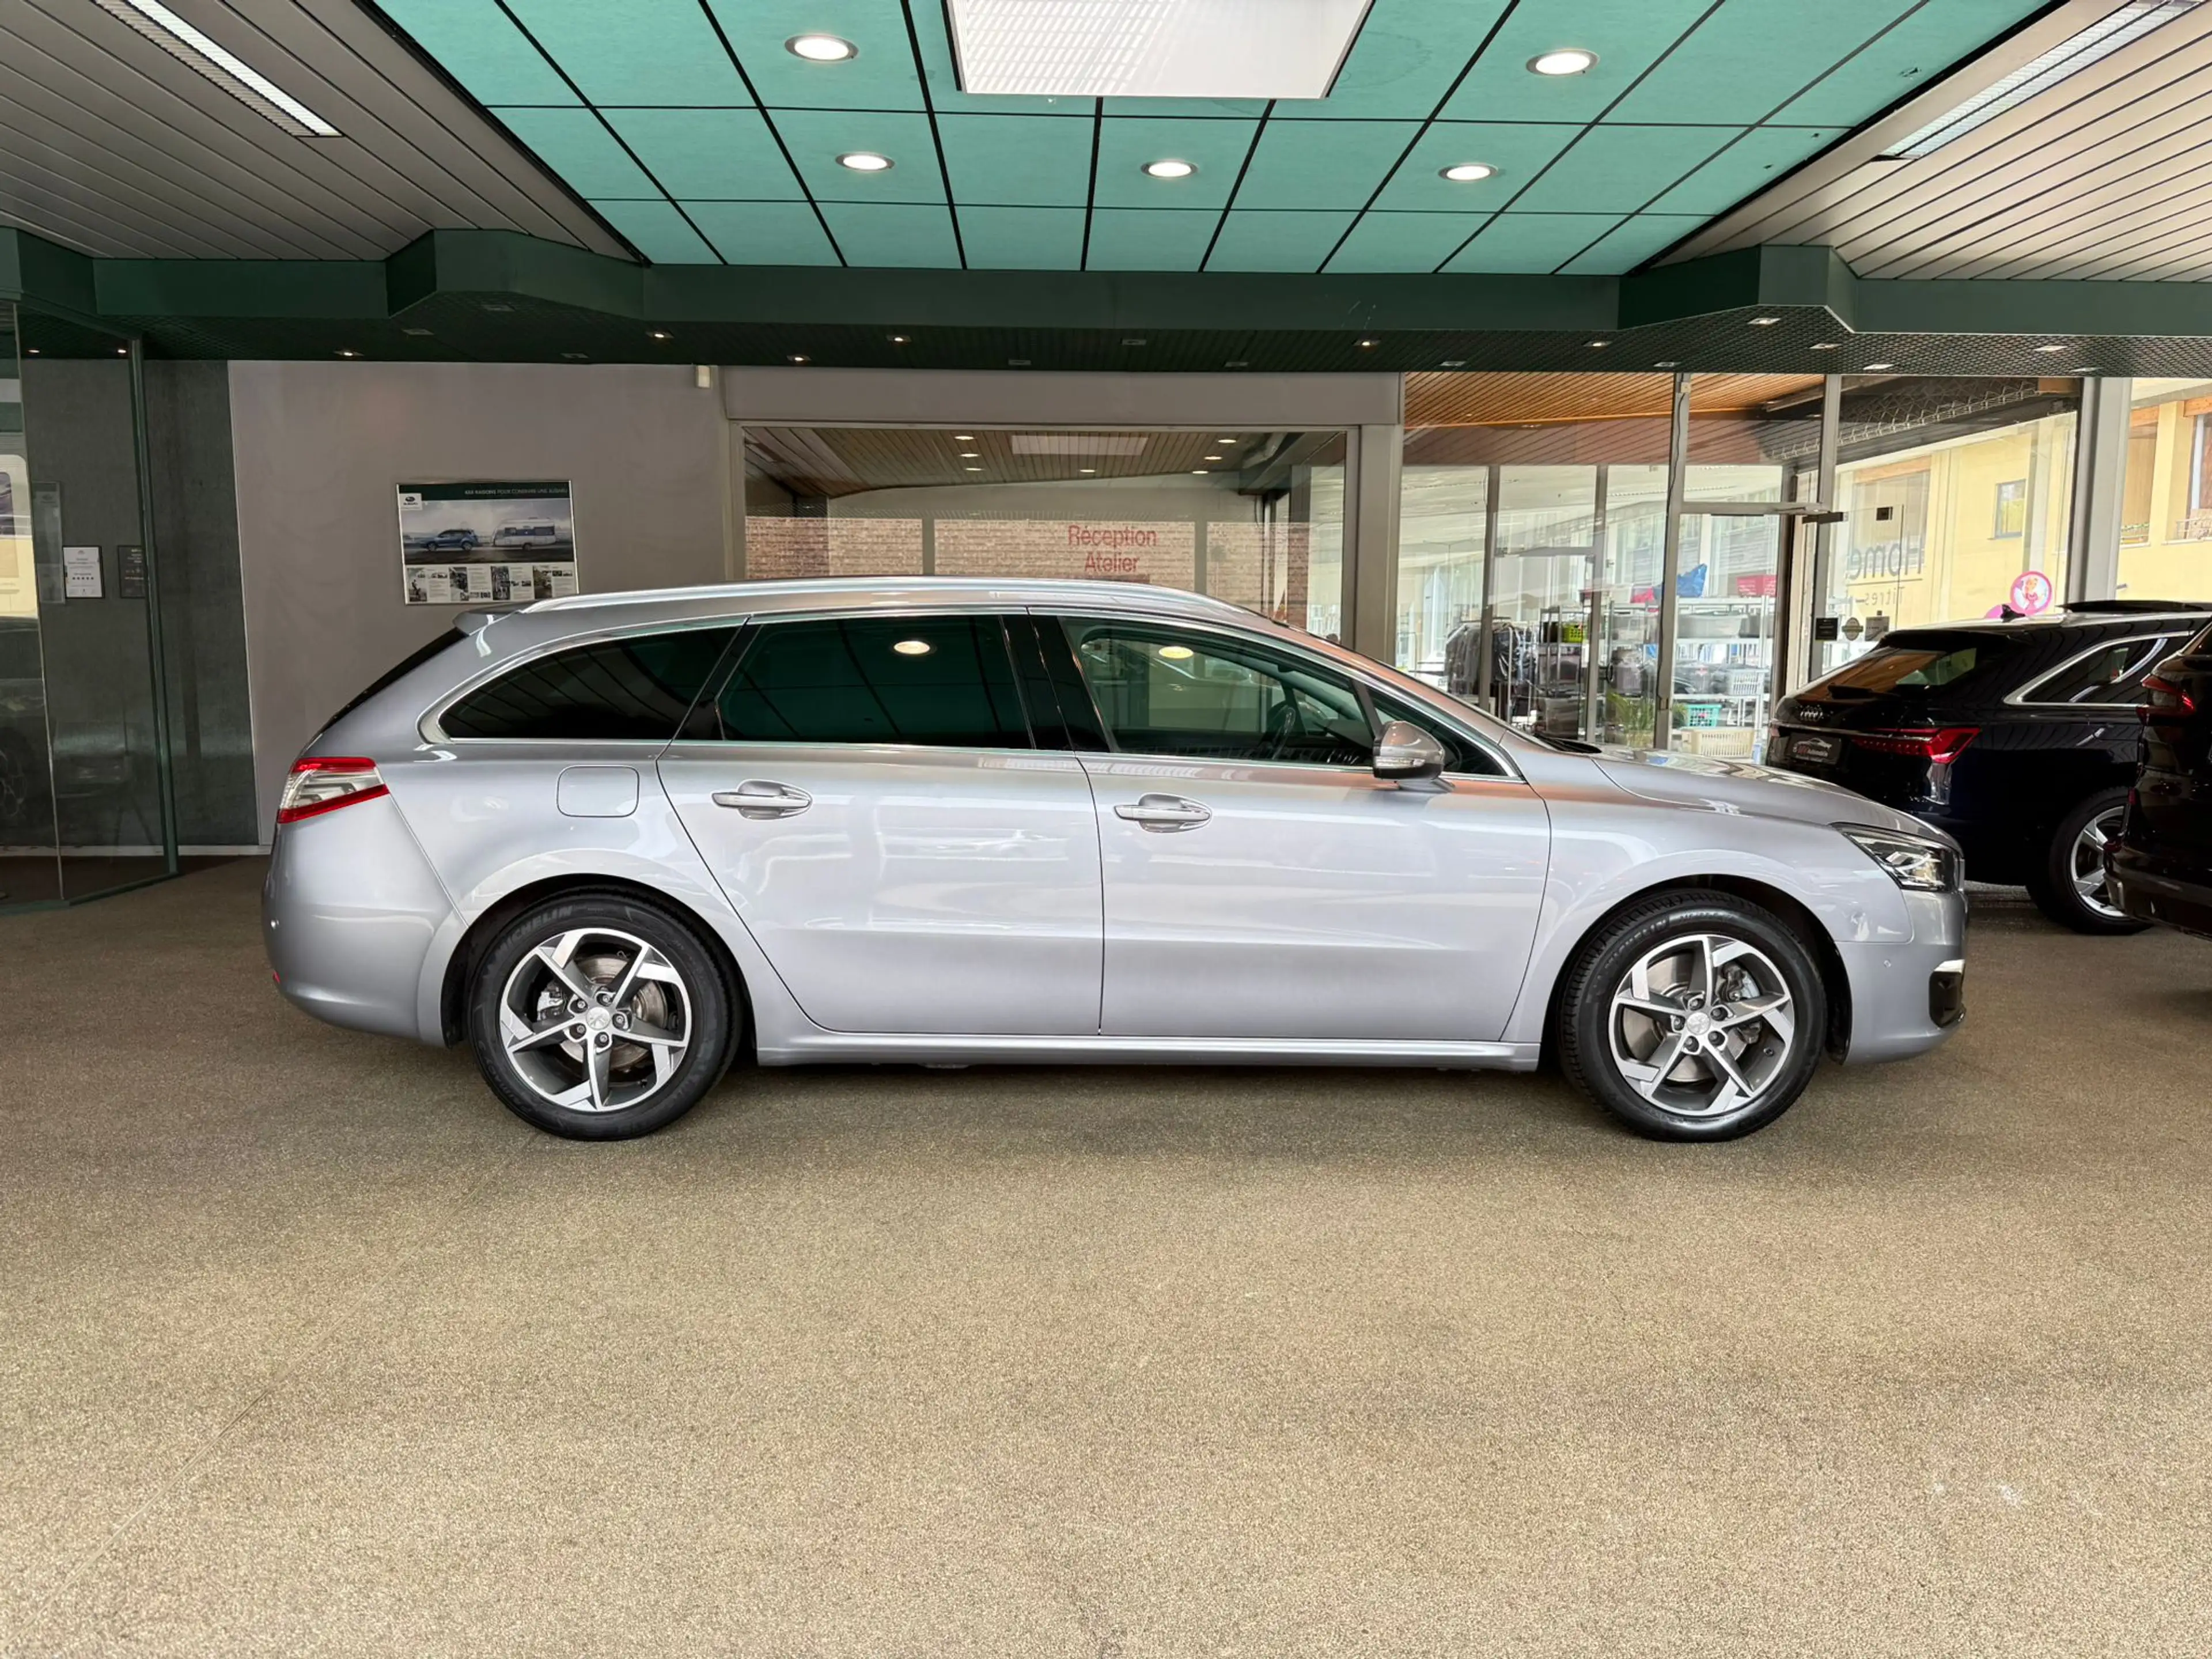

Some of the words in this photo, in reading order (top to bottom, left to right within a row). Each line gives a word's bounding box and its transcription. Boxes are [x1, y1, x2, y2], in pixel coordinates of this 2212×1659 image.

[1068, 525, 1157, 551] Réception
[1085, 552, 1140, 572] Atelier
[494, 904, 573, 961] MICHELIN
